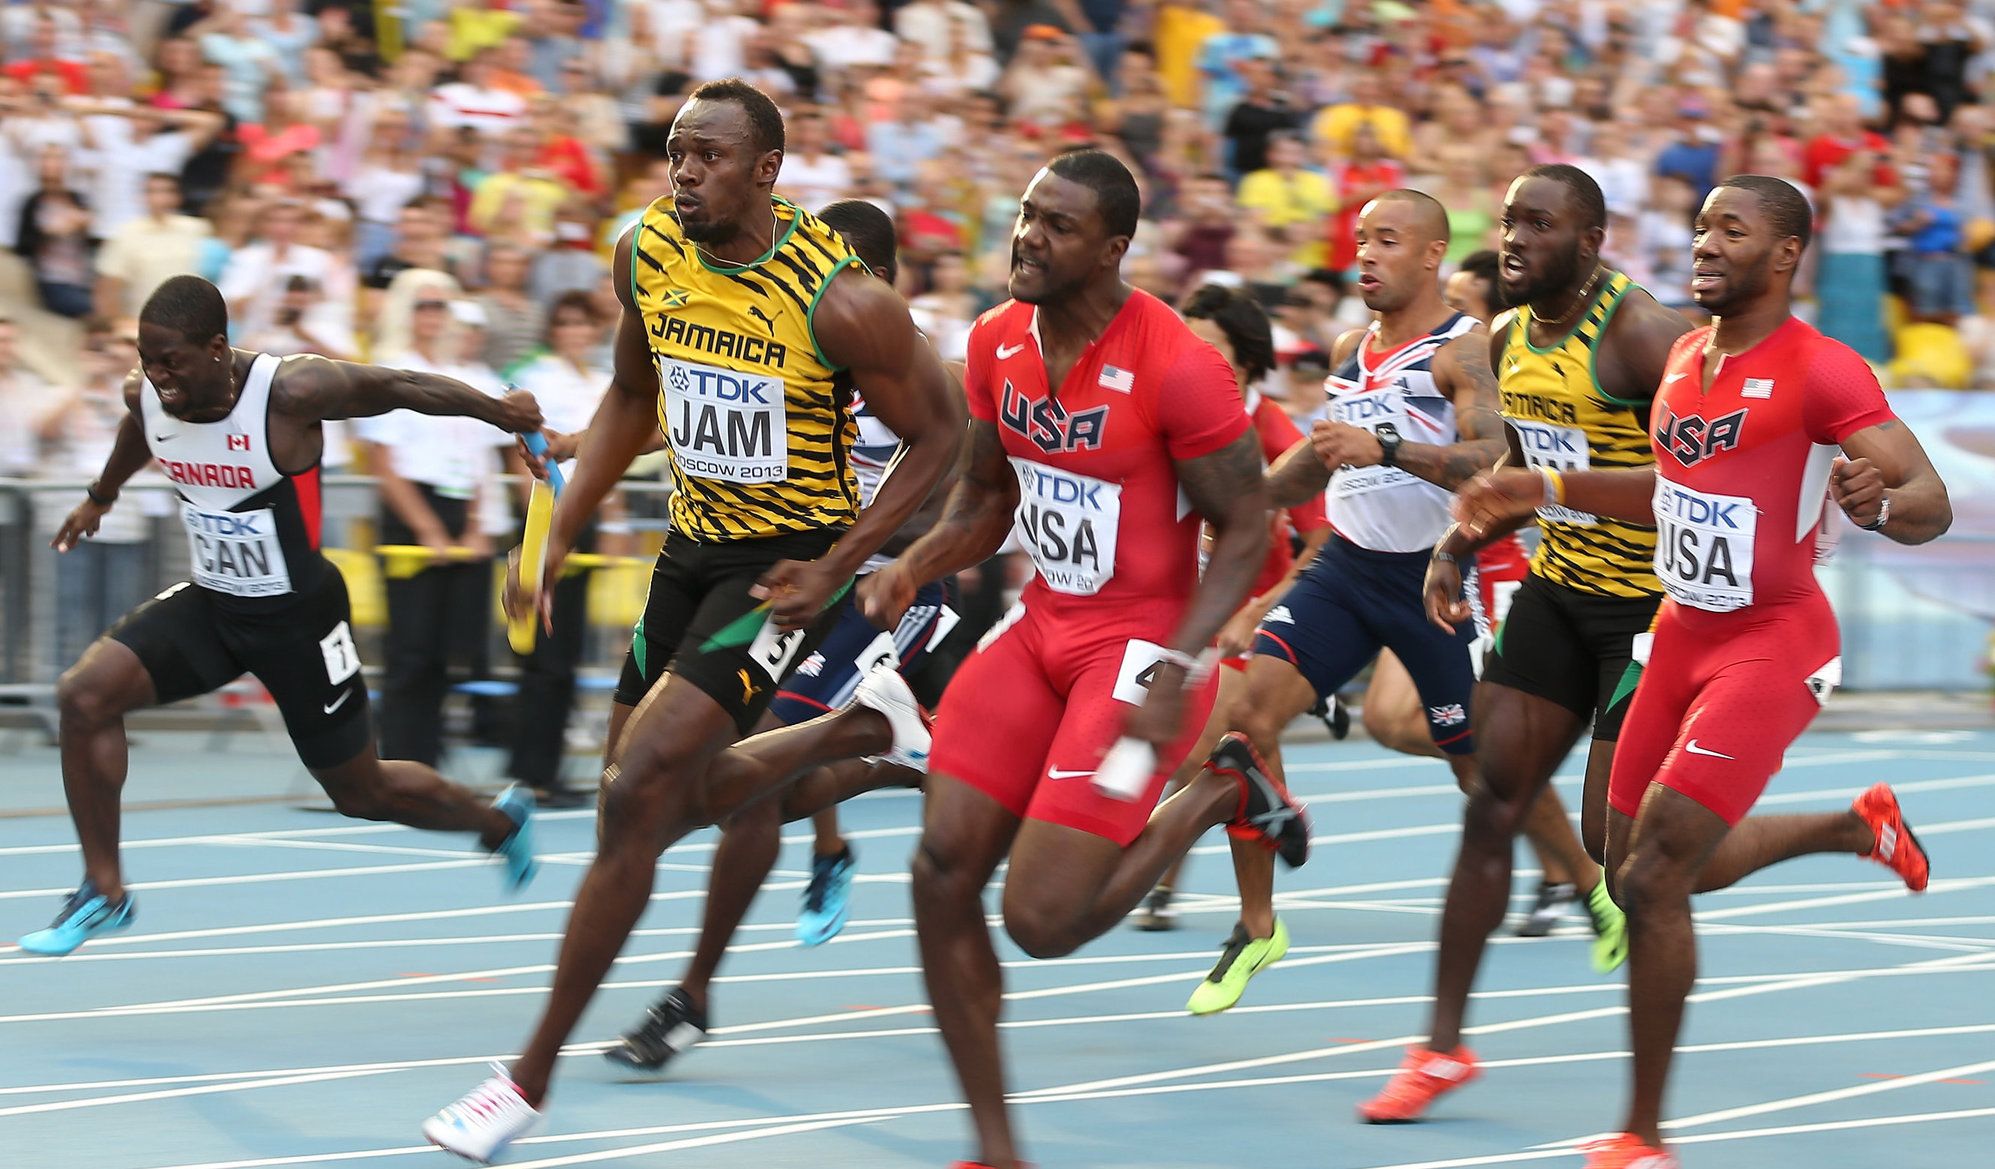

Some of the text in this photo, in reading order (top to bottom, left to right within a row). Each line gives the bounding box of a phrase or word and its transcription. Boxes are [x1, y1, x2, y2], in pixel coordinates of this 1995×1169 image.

[651, 312, 787, 368] JAMAICA
[690, 369, 770, 404] TDK
[1345, 392, 1397, 422] TDK
[673, 398, 773, 458] JAM
[1000, 377, 1110, 455] USA
[1653, 398, 1750, 469] USA
[1517, 426, 1579, 455] TDK
[159, 457, 257, 490] CANADA
[740, 465, 783, 478] 2013
[1034, 471, 1104, 513] TDK
[198, 512, 263, 536] TDK
[1673, 489, 1739, 529] TDK
[195, 533, 271, 578] CAN
[1021, 505, 1100, 573] USA
[1660, 516, 1740, 588] USA
